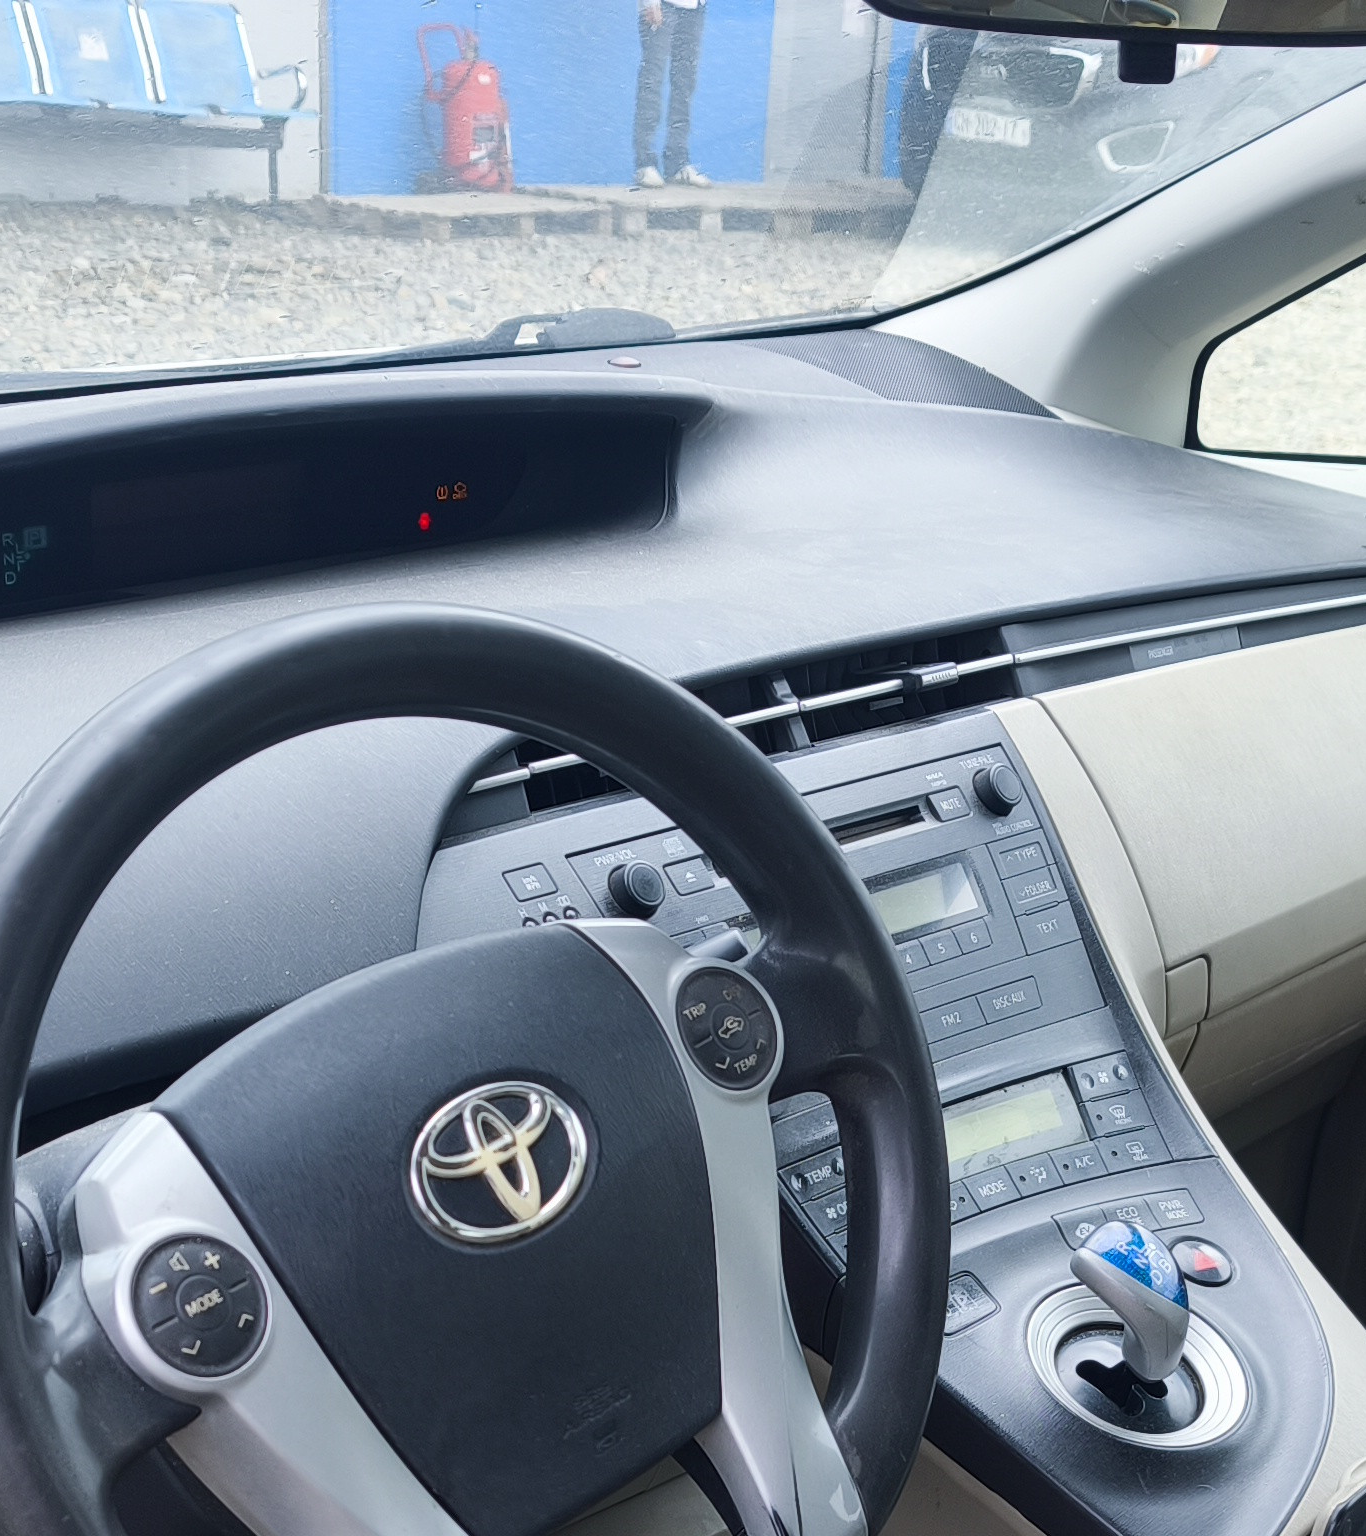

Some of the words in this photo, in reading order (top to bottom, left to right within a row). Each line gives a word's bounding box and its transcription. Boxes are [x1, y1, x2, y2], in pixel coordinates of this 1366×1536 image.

[2, 532, 14, 546] R
[3, 552, 14, 566] N
[5, 571, 16, 585] D
[940, 797, 962, 812] MUTE
[1014, 847, 1038, 862] TYPE
[1024, 880, 1051, 897] FOLDER
[1036, 919, 1059, 934] TEXT
[905, 954, 913, 965] 4
[937, 943, 946, 954] 5
[970, 932, 979, 944] 6
[683, 1002, 707, 1021] TRIP
[941, 1011, 963, 1027] FM2
[733, 1053, 758, 1075] TEMP
[1075, 1155, 1094, 1169] A/C
[804, 1165, 832, 1185] TEMP
[978, 1179, 1008, 1198] MODE
[1116, 1206, 1139, 1220] ECO
[1159, 1200, 1184, 1211] PWR
[1166, 1209, 1189, 1221] MODE
[1079, 1225, 1091, 1236] EV
[1116, 1241, 1130, 1256] R
[1133, 1255, 1147, 1269] N
[1158, 1259, 1172, 1274] B
[1151, 1270, 1163, 1286] D
[185, 1288, 224, 1318] MODE
